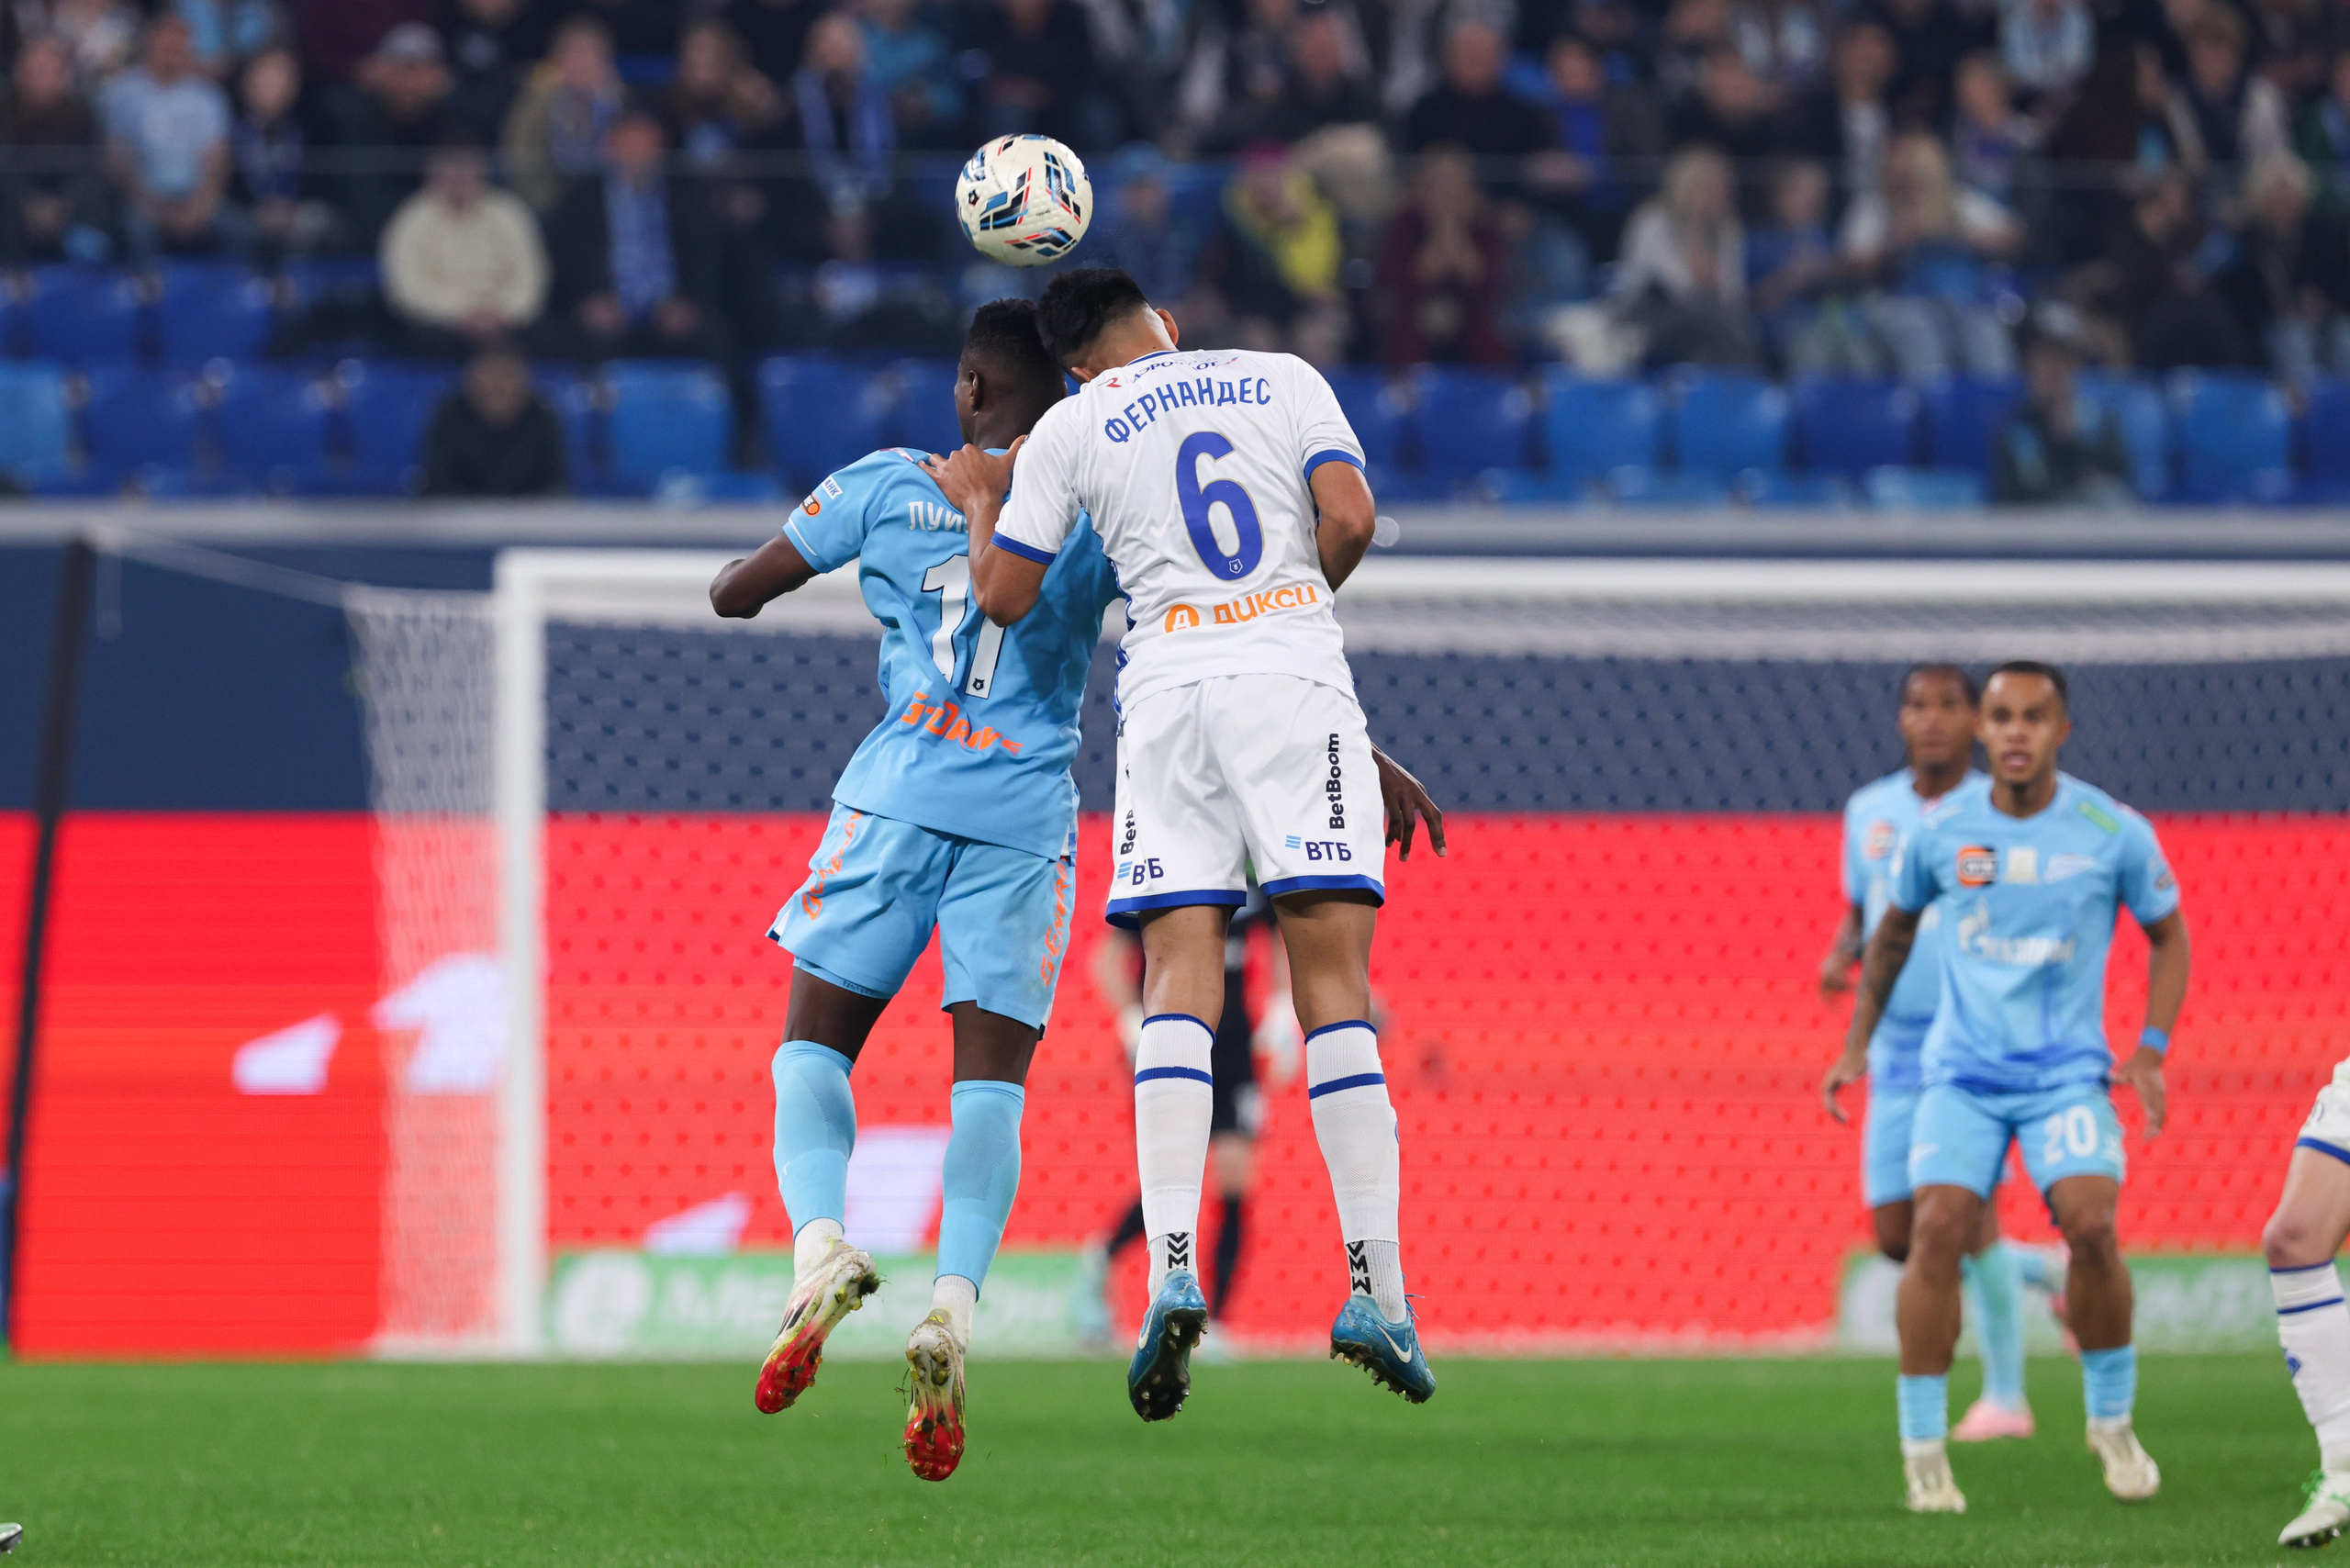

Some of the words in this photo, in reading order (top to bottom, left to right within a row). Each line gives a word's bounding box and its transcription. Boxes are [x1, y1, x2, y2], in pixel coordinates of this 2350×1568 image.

[1133, 360, 1218, 383] АЭРООТ
[1104, 377, 1271, 443] ФЕРНАНДЕС
[907, 500, 969, 533] ЛУИ
[1176, 431, 1265, 581] 6
[1326, 734, 1346, 829] BetBoom
[1132, 857, 1164, 886] ВБ
[1305, 841, 1352, 861] ВТБ
[2044, 1104, 2098, 1165] 20
